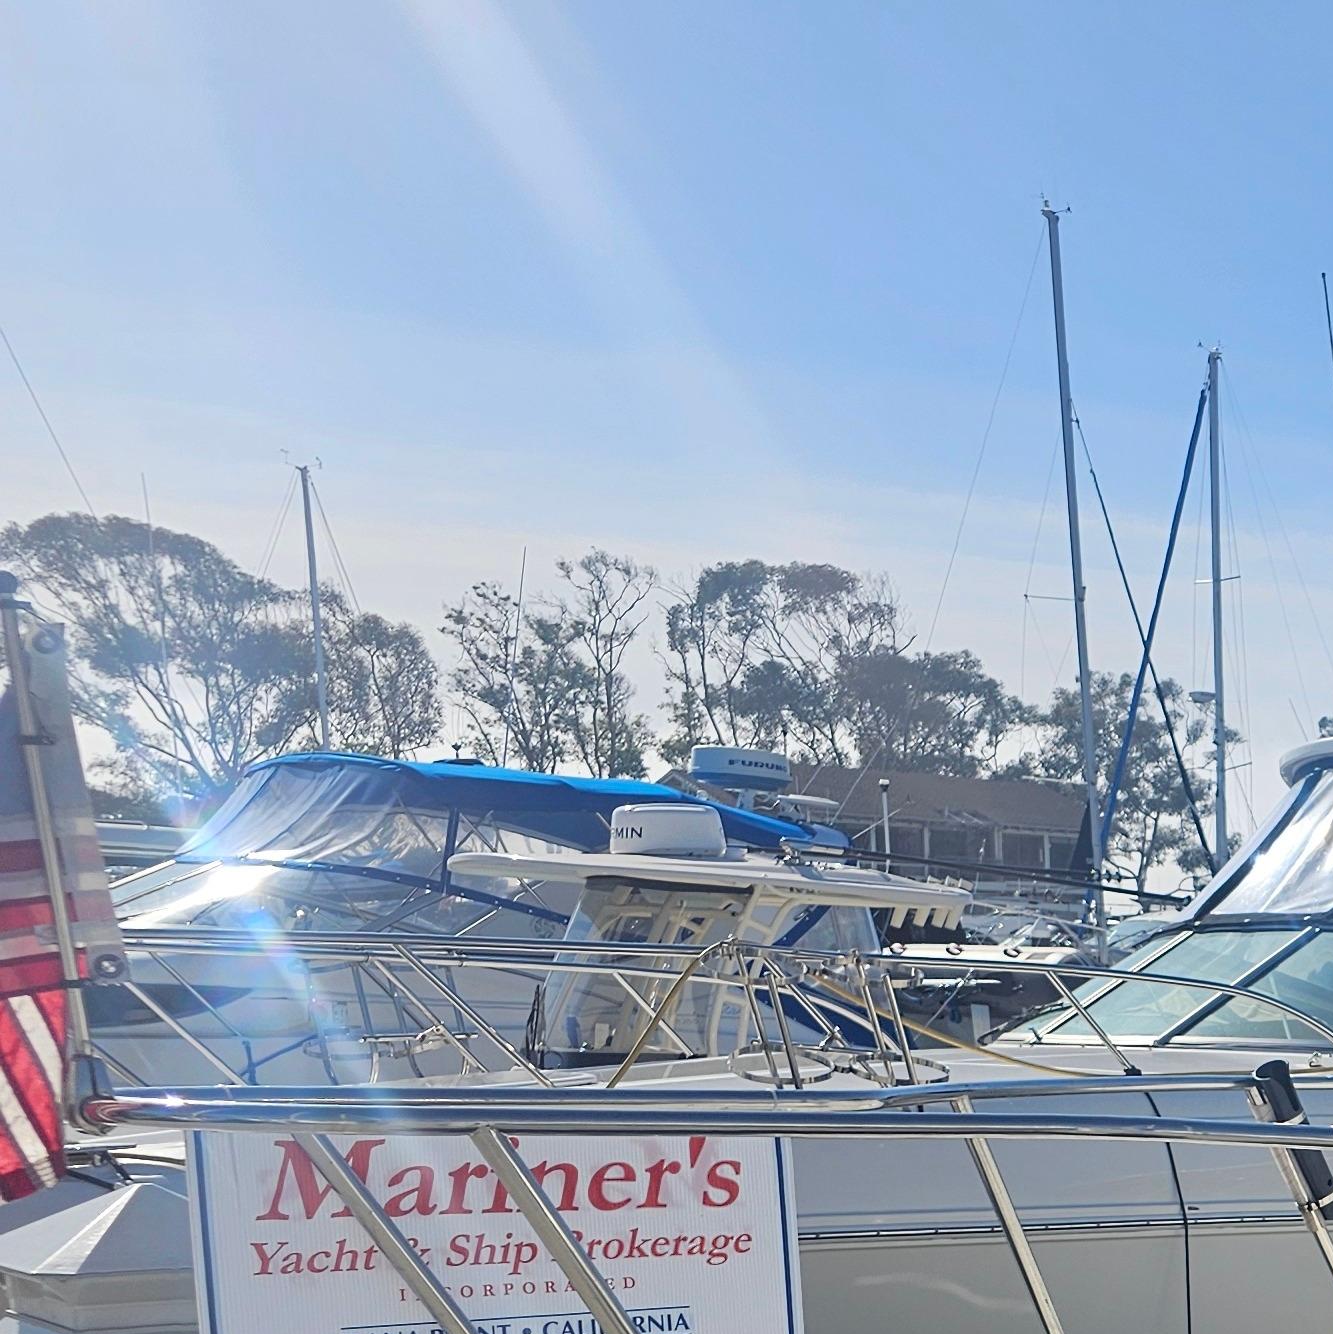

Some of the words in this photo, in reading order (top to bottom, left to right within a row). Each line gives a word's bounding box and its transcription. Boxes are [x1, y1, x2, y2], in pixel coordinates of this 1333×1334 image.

[255, 1136, 741, 1221] Mariner's
[250, 1238, 378, 1276] Yacht
[446, 1232, 538, 1275] Ship
[400, 1276, 636, 1301] IORPORAED
